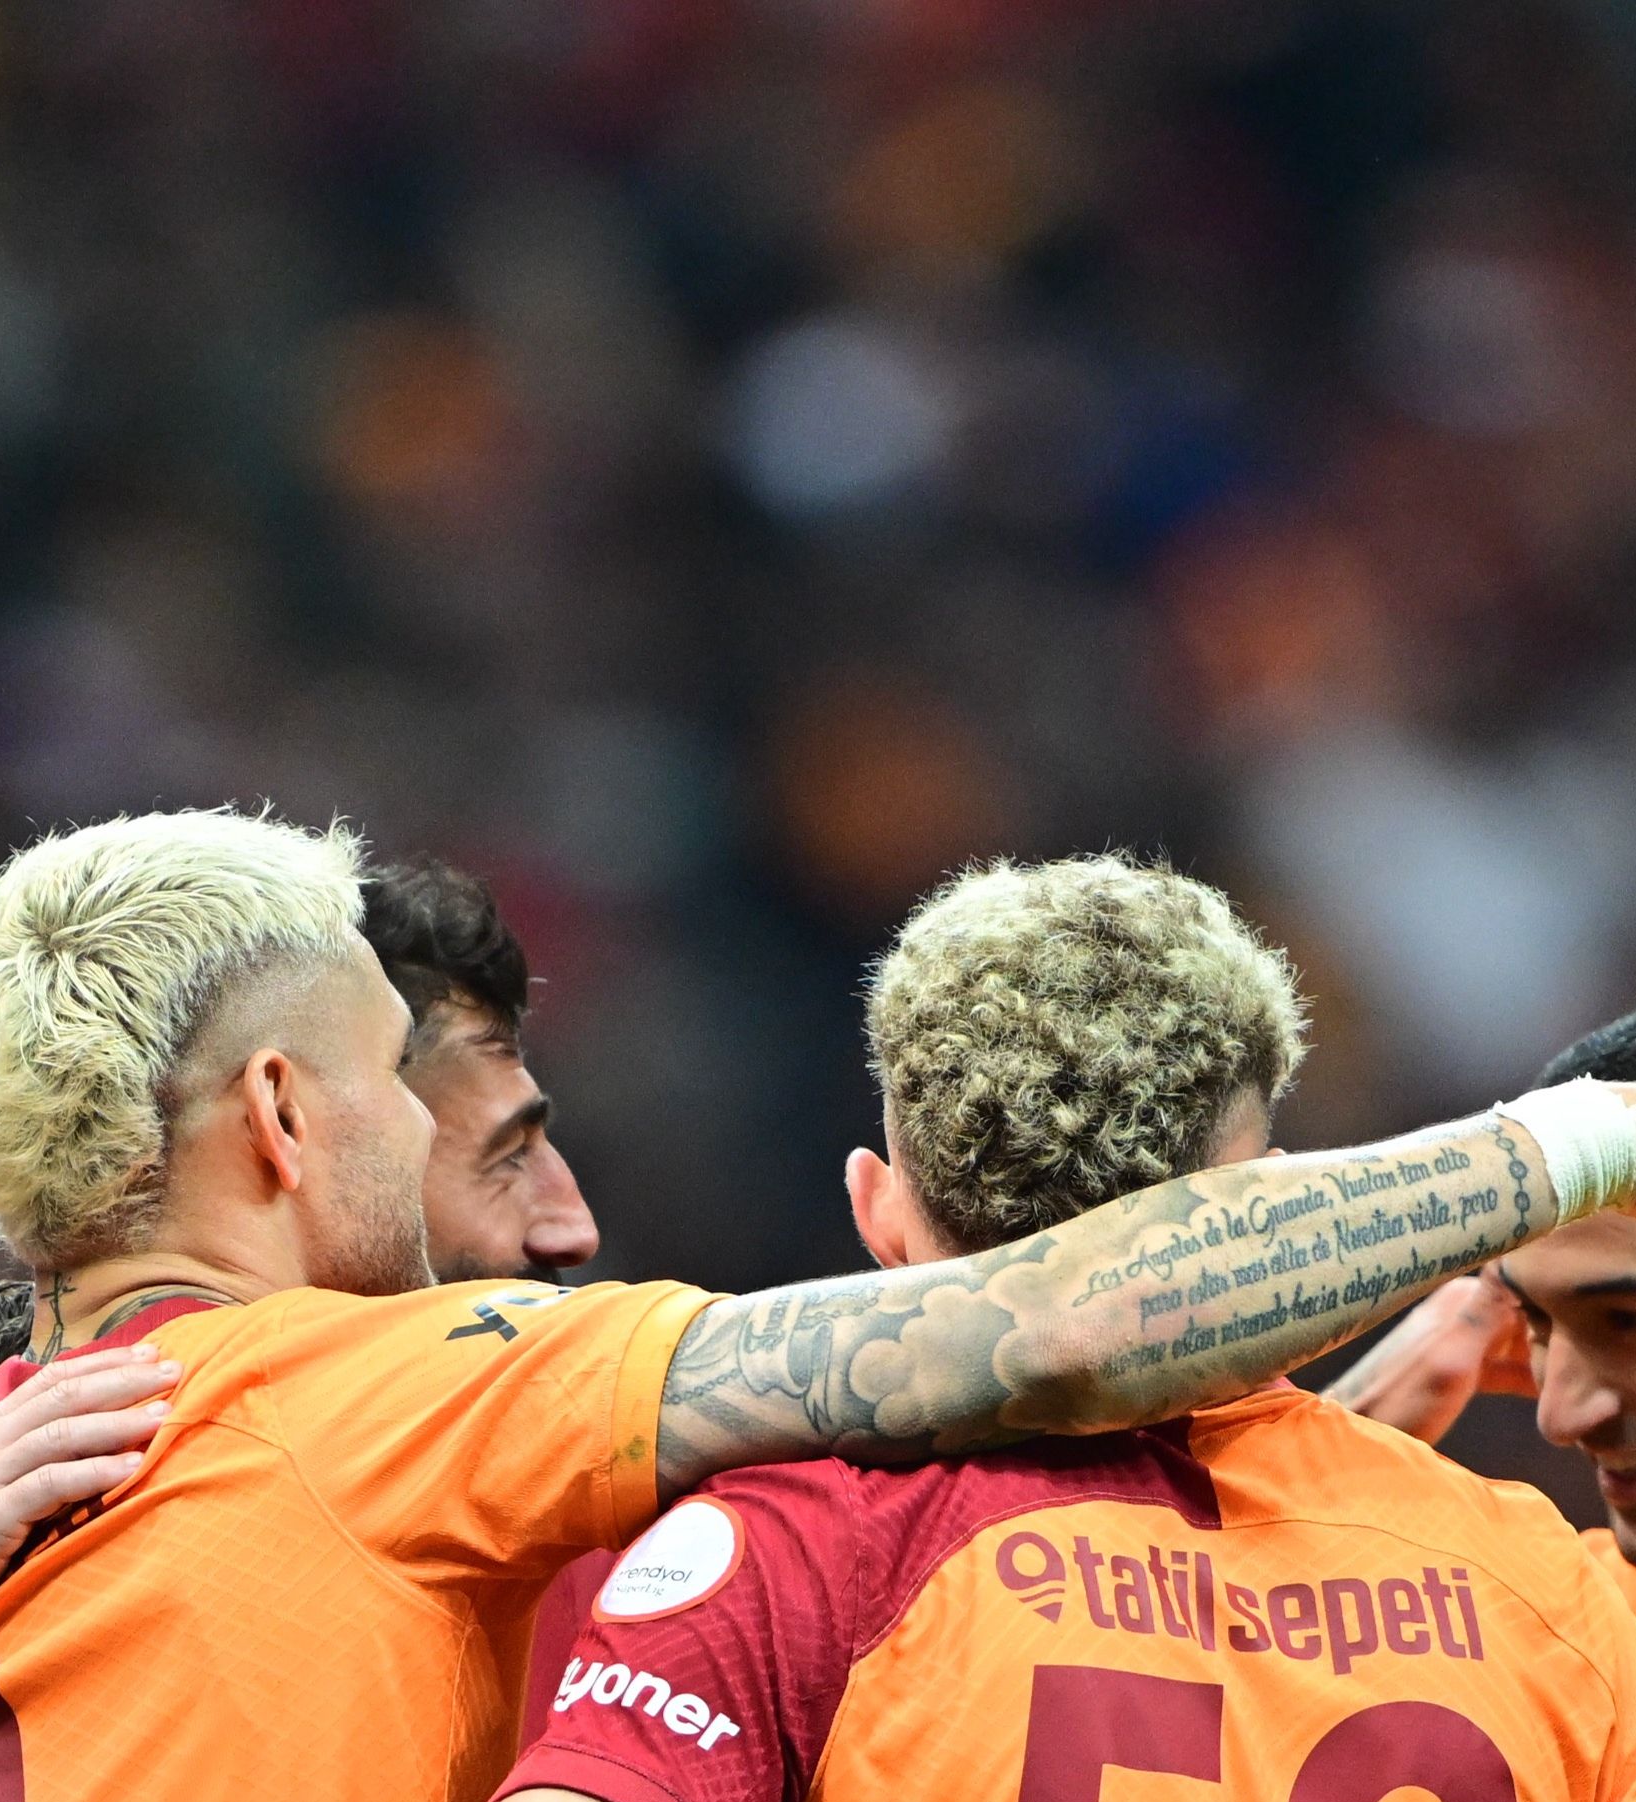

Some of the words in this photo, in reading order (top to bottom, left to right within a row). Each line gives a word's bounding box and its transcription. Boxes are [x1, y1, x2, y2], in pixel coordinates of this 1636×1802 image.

[1072, 1267, 1122, 1307] Los
[1126, 1233, 1202, 1281] Angeles
[1204, 1217, 1223, 1247] de
[1221, 1207, 1248, 1240] la
[1322, 1167, 1398, 1202] Vuelan
[1397, 1160, 1432, 1186] tan
[1434, 1148, 1470, 1174] alto
[1140, 1288, 1182, 1332] para
[1188, 1266, 1230, 1305] estar
[1232, 1259, 1268, 1288] mas
[1270, 1238, 1310, 1275] alla
[1313, 1232, 1331, 1262] de
[1334, 1209, 1406, 1264] Nuestra
[1459, 1188, 1498, 1230] pero
[1172, 1315, 1216, 1359] estan
[1221, 1291, 1287, 1344] mirando
[1290, 1281, 1338, 1321] hacia
[1343, 1265, 1391, 1310] abajo
[1392, 1247, 1436, 1291] sobre
